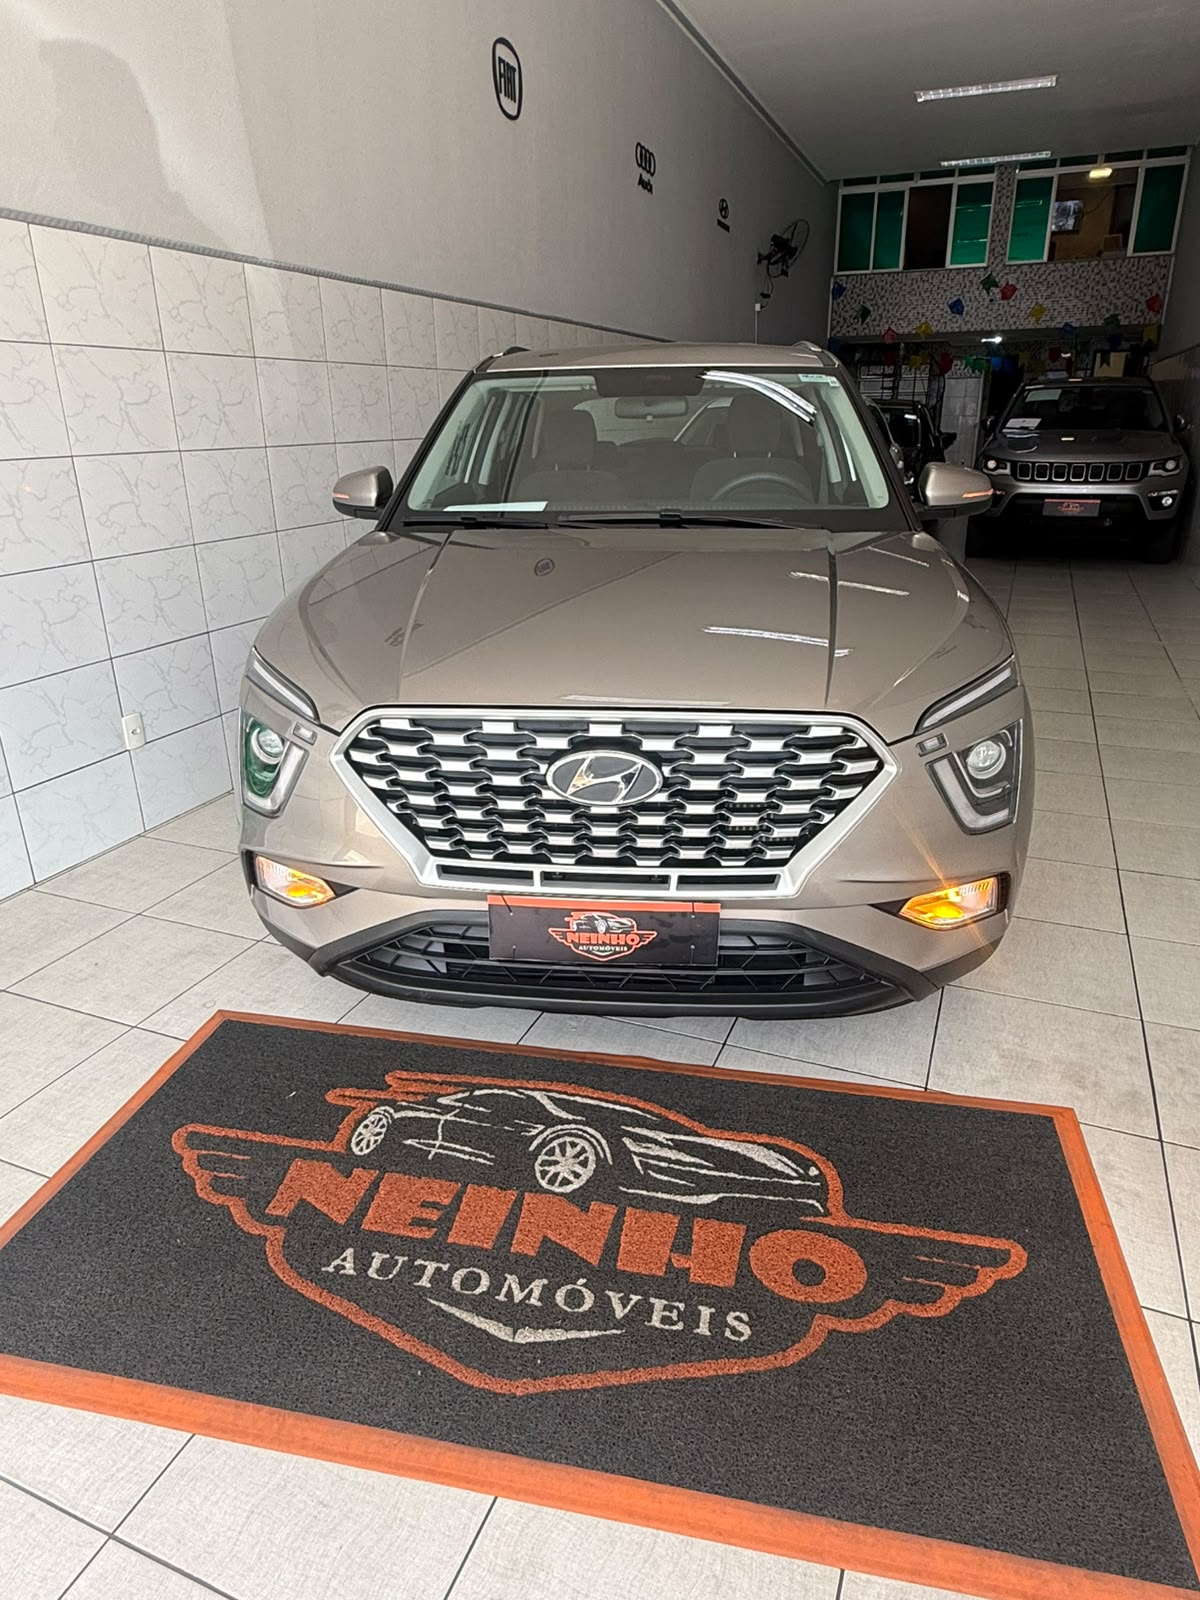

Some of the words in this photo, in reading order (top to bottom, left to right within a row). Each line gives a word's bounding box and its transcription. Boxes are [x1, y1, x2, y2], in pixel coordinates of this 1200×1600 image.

[498, 56, 516, 103] FIAT
[566, 932, 640, 946] NEINHO
[266, 1160, 868, 1304] NEINHO
[321, 1246, 754, 1343] AUTOMÓVEIS
